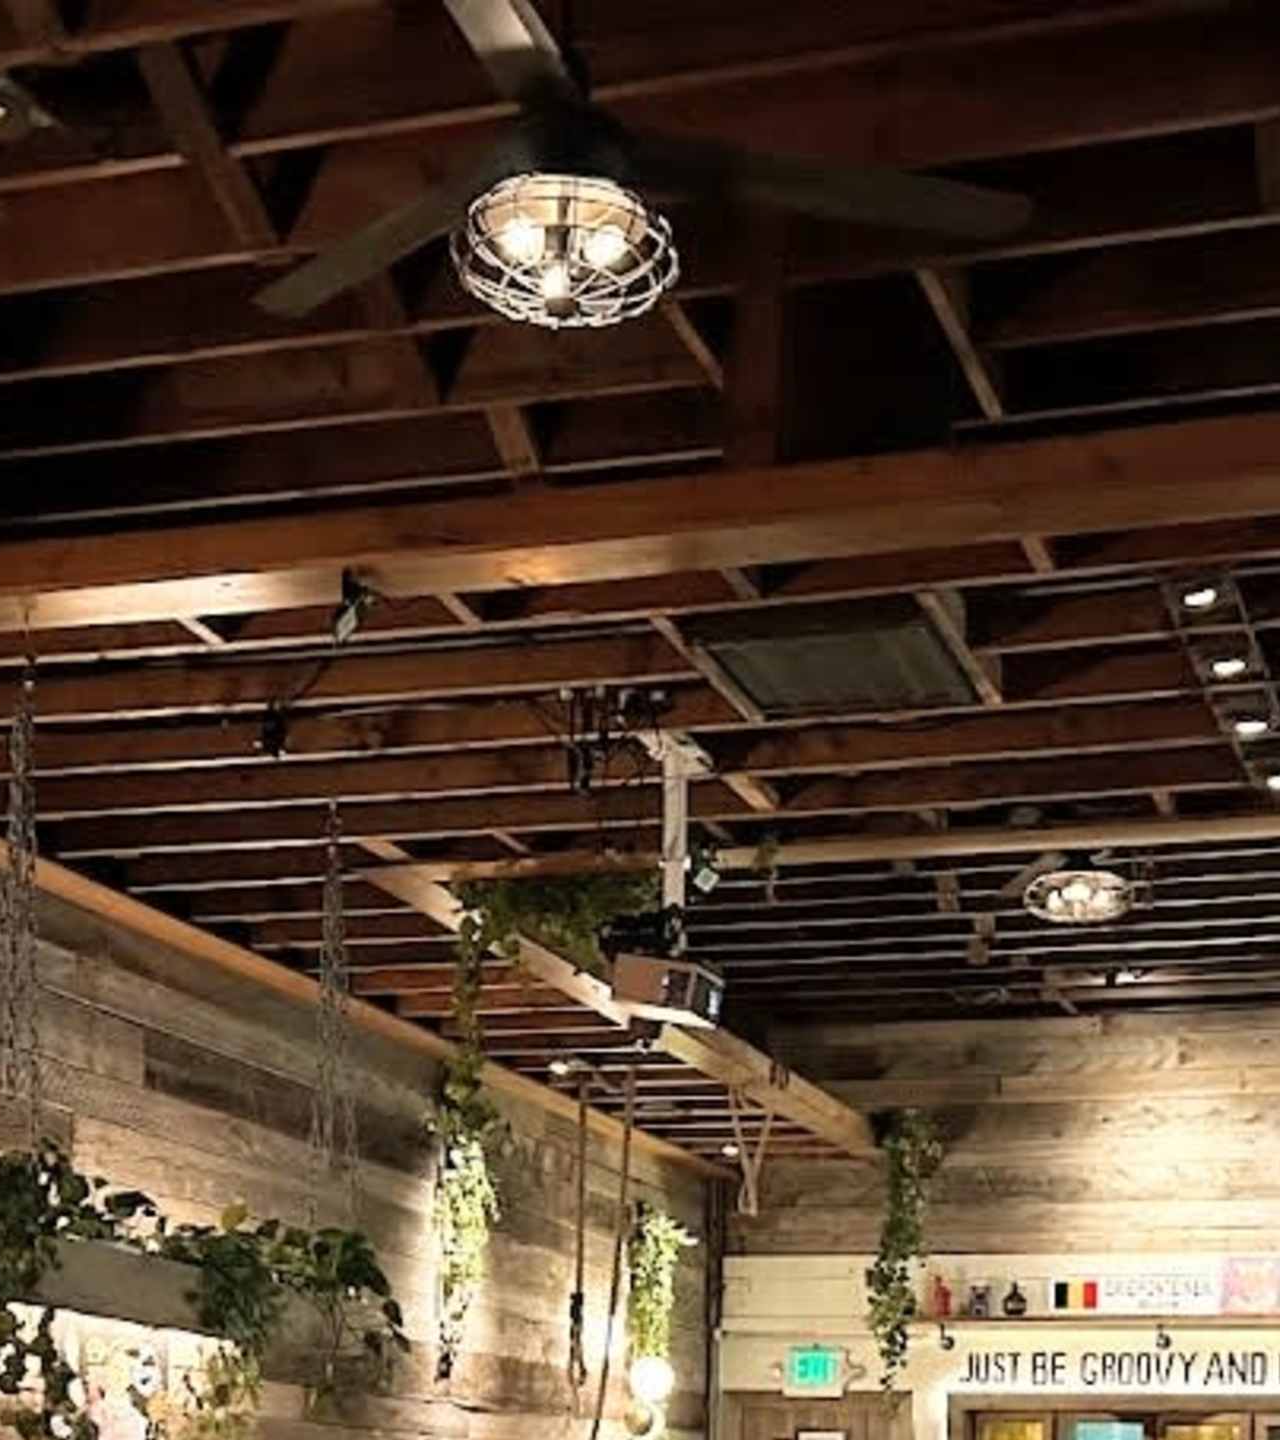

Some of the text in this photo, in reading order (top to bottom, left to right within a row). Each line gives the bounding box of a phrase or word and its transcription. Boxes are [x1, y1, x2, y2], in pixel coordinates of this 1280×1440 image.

[959, 1351, 1021, 1384] JUST
[1031, 1351, 1067, 1385] BE
[1080, 1351, 1198, 1386] GROOVY
[1203, 1351, 1268, 1386] AND
